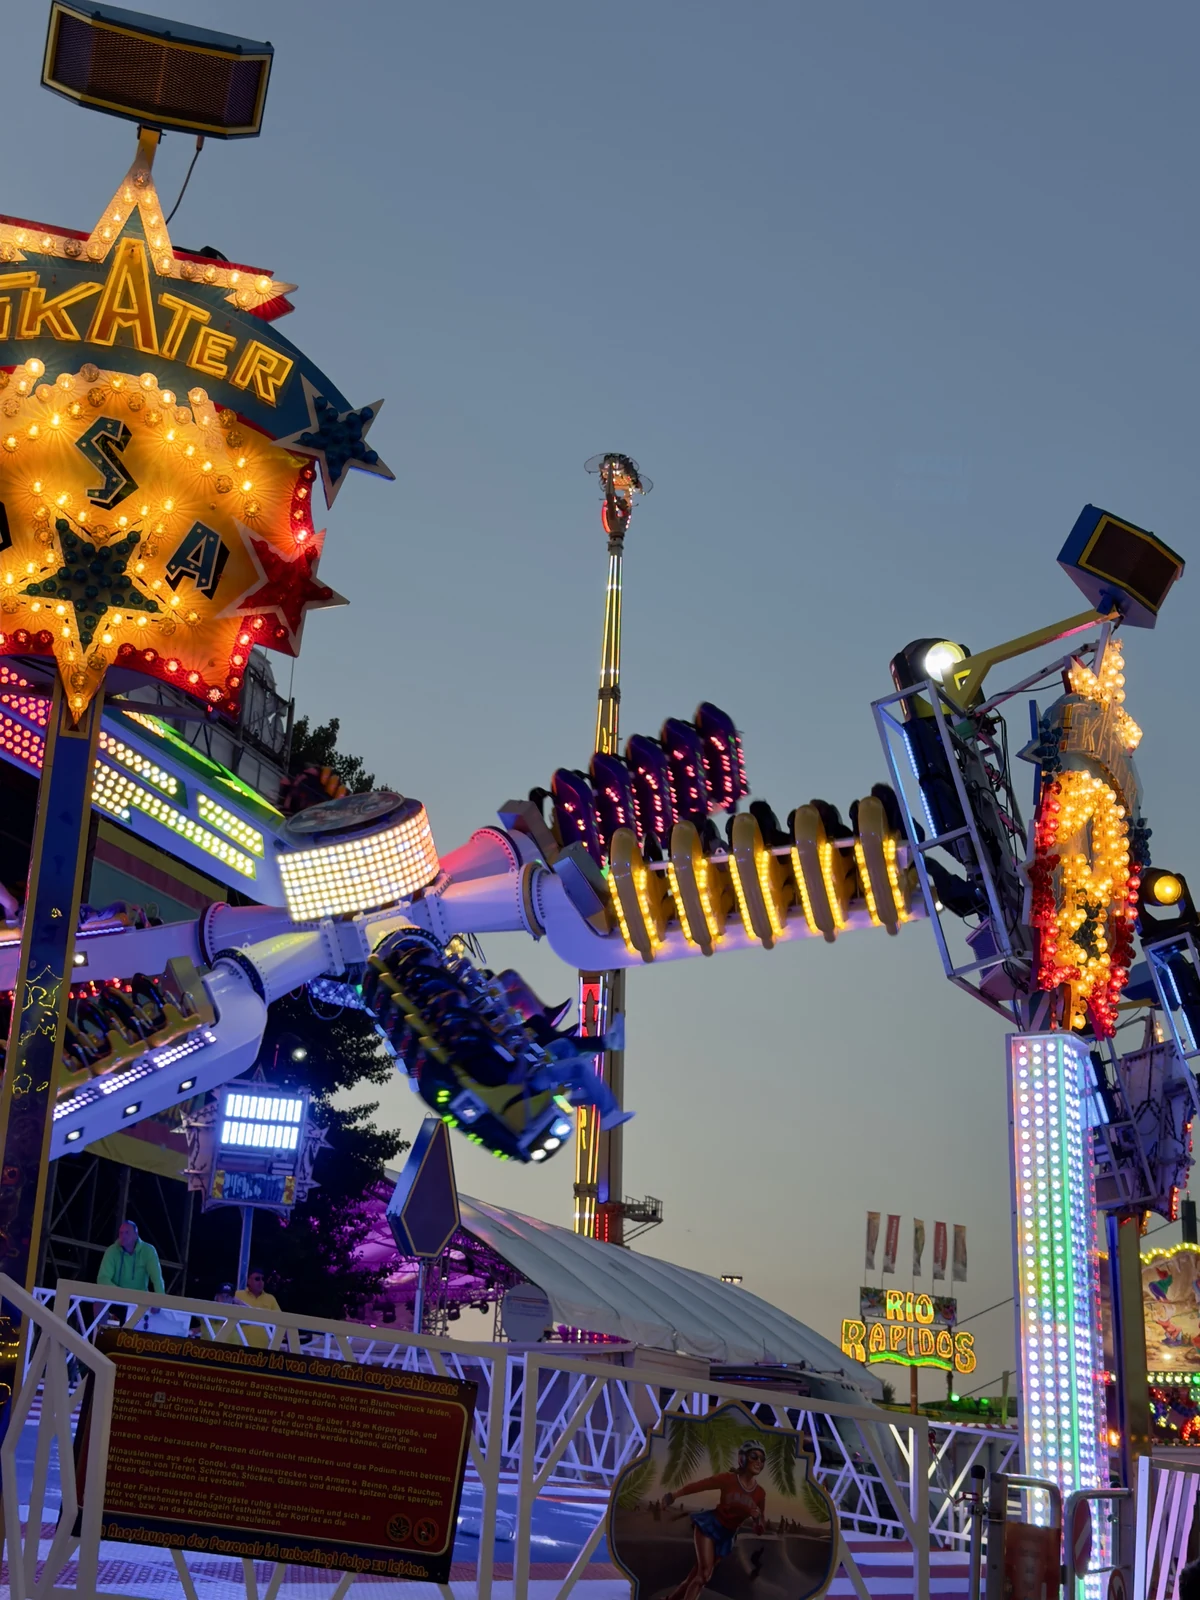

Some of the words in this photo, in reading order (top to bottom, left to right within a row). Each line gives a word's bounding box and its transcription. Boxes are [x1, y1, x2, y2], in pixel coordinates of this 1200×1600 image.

[74, 415, 139, 510] S
[165, 520, 230, 600] A
[886, 1289, 935, 1324] RIO
[116, 1331, 182, 1355] Folgender
[181, 1341, 268, 1367] Personenkreis
[268, 1353, 285, 1369] ist
[284, 1359, 307, 1373] von
[307, 1359, 330, 1376] der
[330, 1363, 363, 1381] Fahrt
[364, 1370, 459, 1395] ausgeschlossen:
[841, 1318, 977, 1374] RAPIDOS
[127, 1373, 150, 1381] sowie
[182, 1380, 243, 1395] Kreislaufkranke
[263, 1391, 309, 1404] Schwangere
[312, 1398, 336, 1408] dürfen
[338, 1402, 357, 1411] nicht
[132, 1391, 153, 1399] unter
[218, 1401, 254, 1413] Personen
[257, 1408, 277, 1416] unter
[306, 1415, 324, 1423] oder
[325, 1417, 342, 1425] über
[150, 1367, 163, 1375] die
[339, 1395, 356, 1403] oder
[370, 1398, 424, 1413] Bluthochdruck
[426, 1406, 451, 1418] leiden,
[154, 1409, 221, 1425] Sicherheitsbügel
[222, 1420, 242, 1428] nicht
[244, 1423, 268, 1432] sicher
[270, 1426, 318, 1438] festgehalten
[319, 1434, 347, 1443] werden
[381, 1441, 406, 1451] dürfen
[408, 1446, 427, 1454] nicht
[173, 1404, 198, 1413] Grund
[200, 1407, 219, 1416] ihres
[271, 1418, 289, 1426] oder
[291, 1420, 313, 1429] durch
[315, 1424, 372, 1438] Behinderungen
[374, 1432, 396, 1441] durch
[398, 1435, 410, 1443] die
[107, 1454, 151, 1466] Mitnehmen
[170, 1462, 196, 1474] Tieren,
[276, 1477, 307, 1487] Gläsern
[326, 1485, 356, 1494] anderen
[359, 1489, 386, 1498] spitzen
[407, 1496, 443, 1506] sperrigen
[109, 1445, 164, 1459] Hinauslehnen
[182, 1455, 196, 1463] der
[230, 1462, 244, 1470] das
[246, 1464, 306, 1479] Hinausstrecken
[324, 1475, 349, 1484] Armen
[391, 1484, 405, 1492] das
[114, 1464, 136, 1472] losen
[138, 1467, 195, 1480] Gegenständen
[143, 1434, 162, 1442] oder
[163, 1436, 207, 1448] berauschte
[209, 1443, 246, 1454] Personen
[248, 1448, 274, 1457] dürfen
[297, 1456, 334, 1466] mitfahren
[352, 1462, 366, 1470] das
[368, 1465, 396, 1474] Podium
[398, 1469, 418, 1477] nicht
[419, 1472, 452, 1482] betreten.
[123, 1481, 136, 1490] der
[138, 1483, 160, 1493] Fahrt
[161, 1487, 193, 1497] müssen
[194, 1491, 207, 1499] die
[209, 1493, 248, 1505] Fahrgäste
[250, 1499, 271, 1509] ruhig
[273, 1502, 324, 1515] sitzenbleiben
[343, 1511, 359, 1519] sich
[125, 1491, 180, 1504] vorgesehenen
[275, 1510, 288, 1518] der
[290, 1512, 309, 1522] Kopf
[310, 1515, 320, 1523] ist
[334, 1518, 346, 1526] die
[170, 1505, 185, 1513] das
[187, 1507, 233, 1520] Kopfpolster
[107, 1522, 185, 1546] Anordnungen
[186, 1532, 208, 1548] des
[209, 1535, 264, 1555] Personals
[264, 1543, 279, 1557] ist
[278, 1546, 339, 1567] unbedingt
[338, 1552, 371, 1571] Folge
[370, 1559, 387, 1571] zu
[386, 1559, 428, 1577] leisten.
